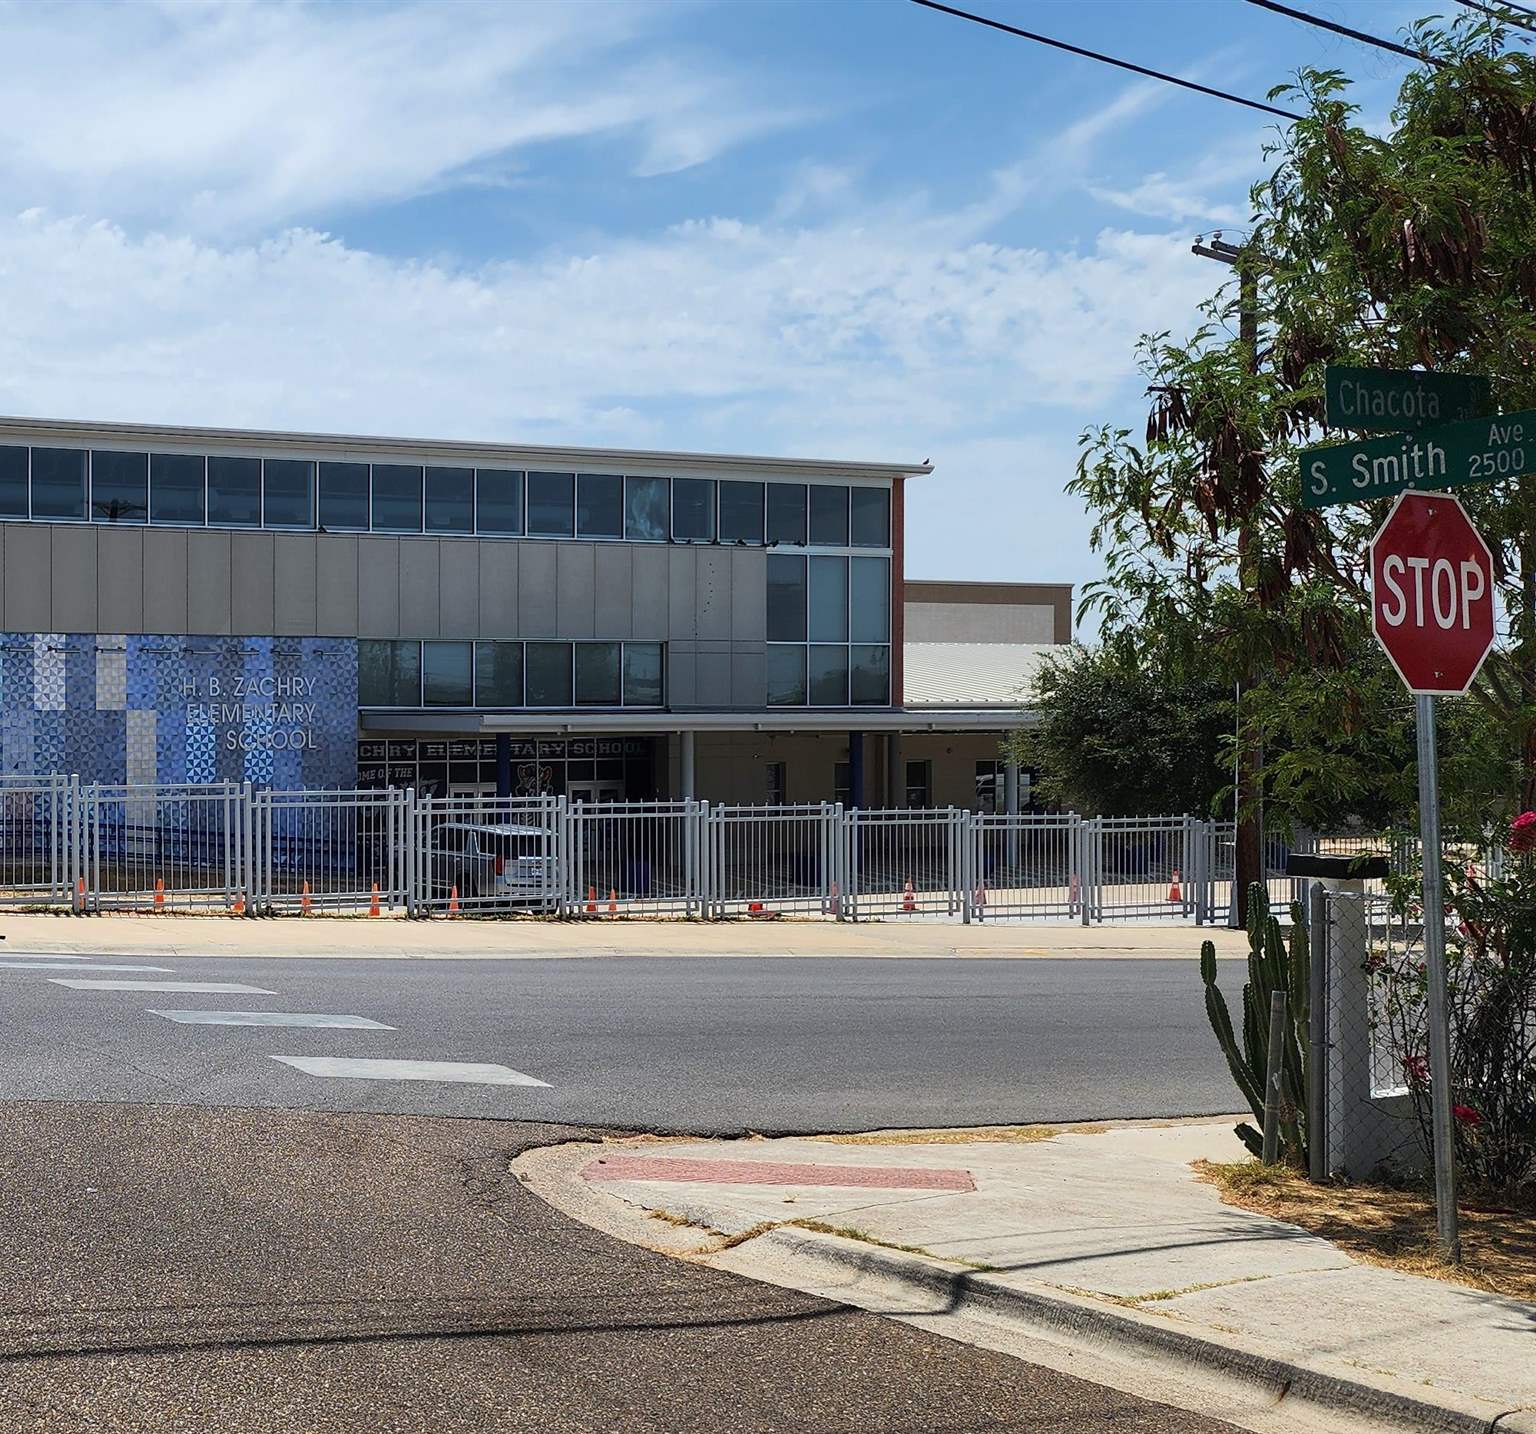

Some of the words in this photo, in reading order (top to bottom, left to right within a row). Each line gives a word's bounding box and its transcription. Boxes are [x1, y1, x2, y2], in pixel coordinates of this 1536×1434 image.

[1339, 379, 1440, 420] Chacota
[1488, 423, 1524, 448] Ave
[1310, 460, 1338, 496] S.
[1351, 441, 1447, 489] Smith
[1468, 448, 1526, 479] 2500
[1381, 554, 1485, 630] STOP
[182, 677, 202, 697] H.
[209, 677, 227, 697] B.
[234, 676, 317, 697] ZACHRY
[186, 703, 317, 723] ELEMENTARY
[226, 730, 317, 750] SCHOOL
[426, 743, 565, 758] ELEMETARY
[393, 767, 414, 779] THE
